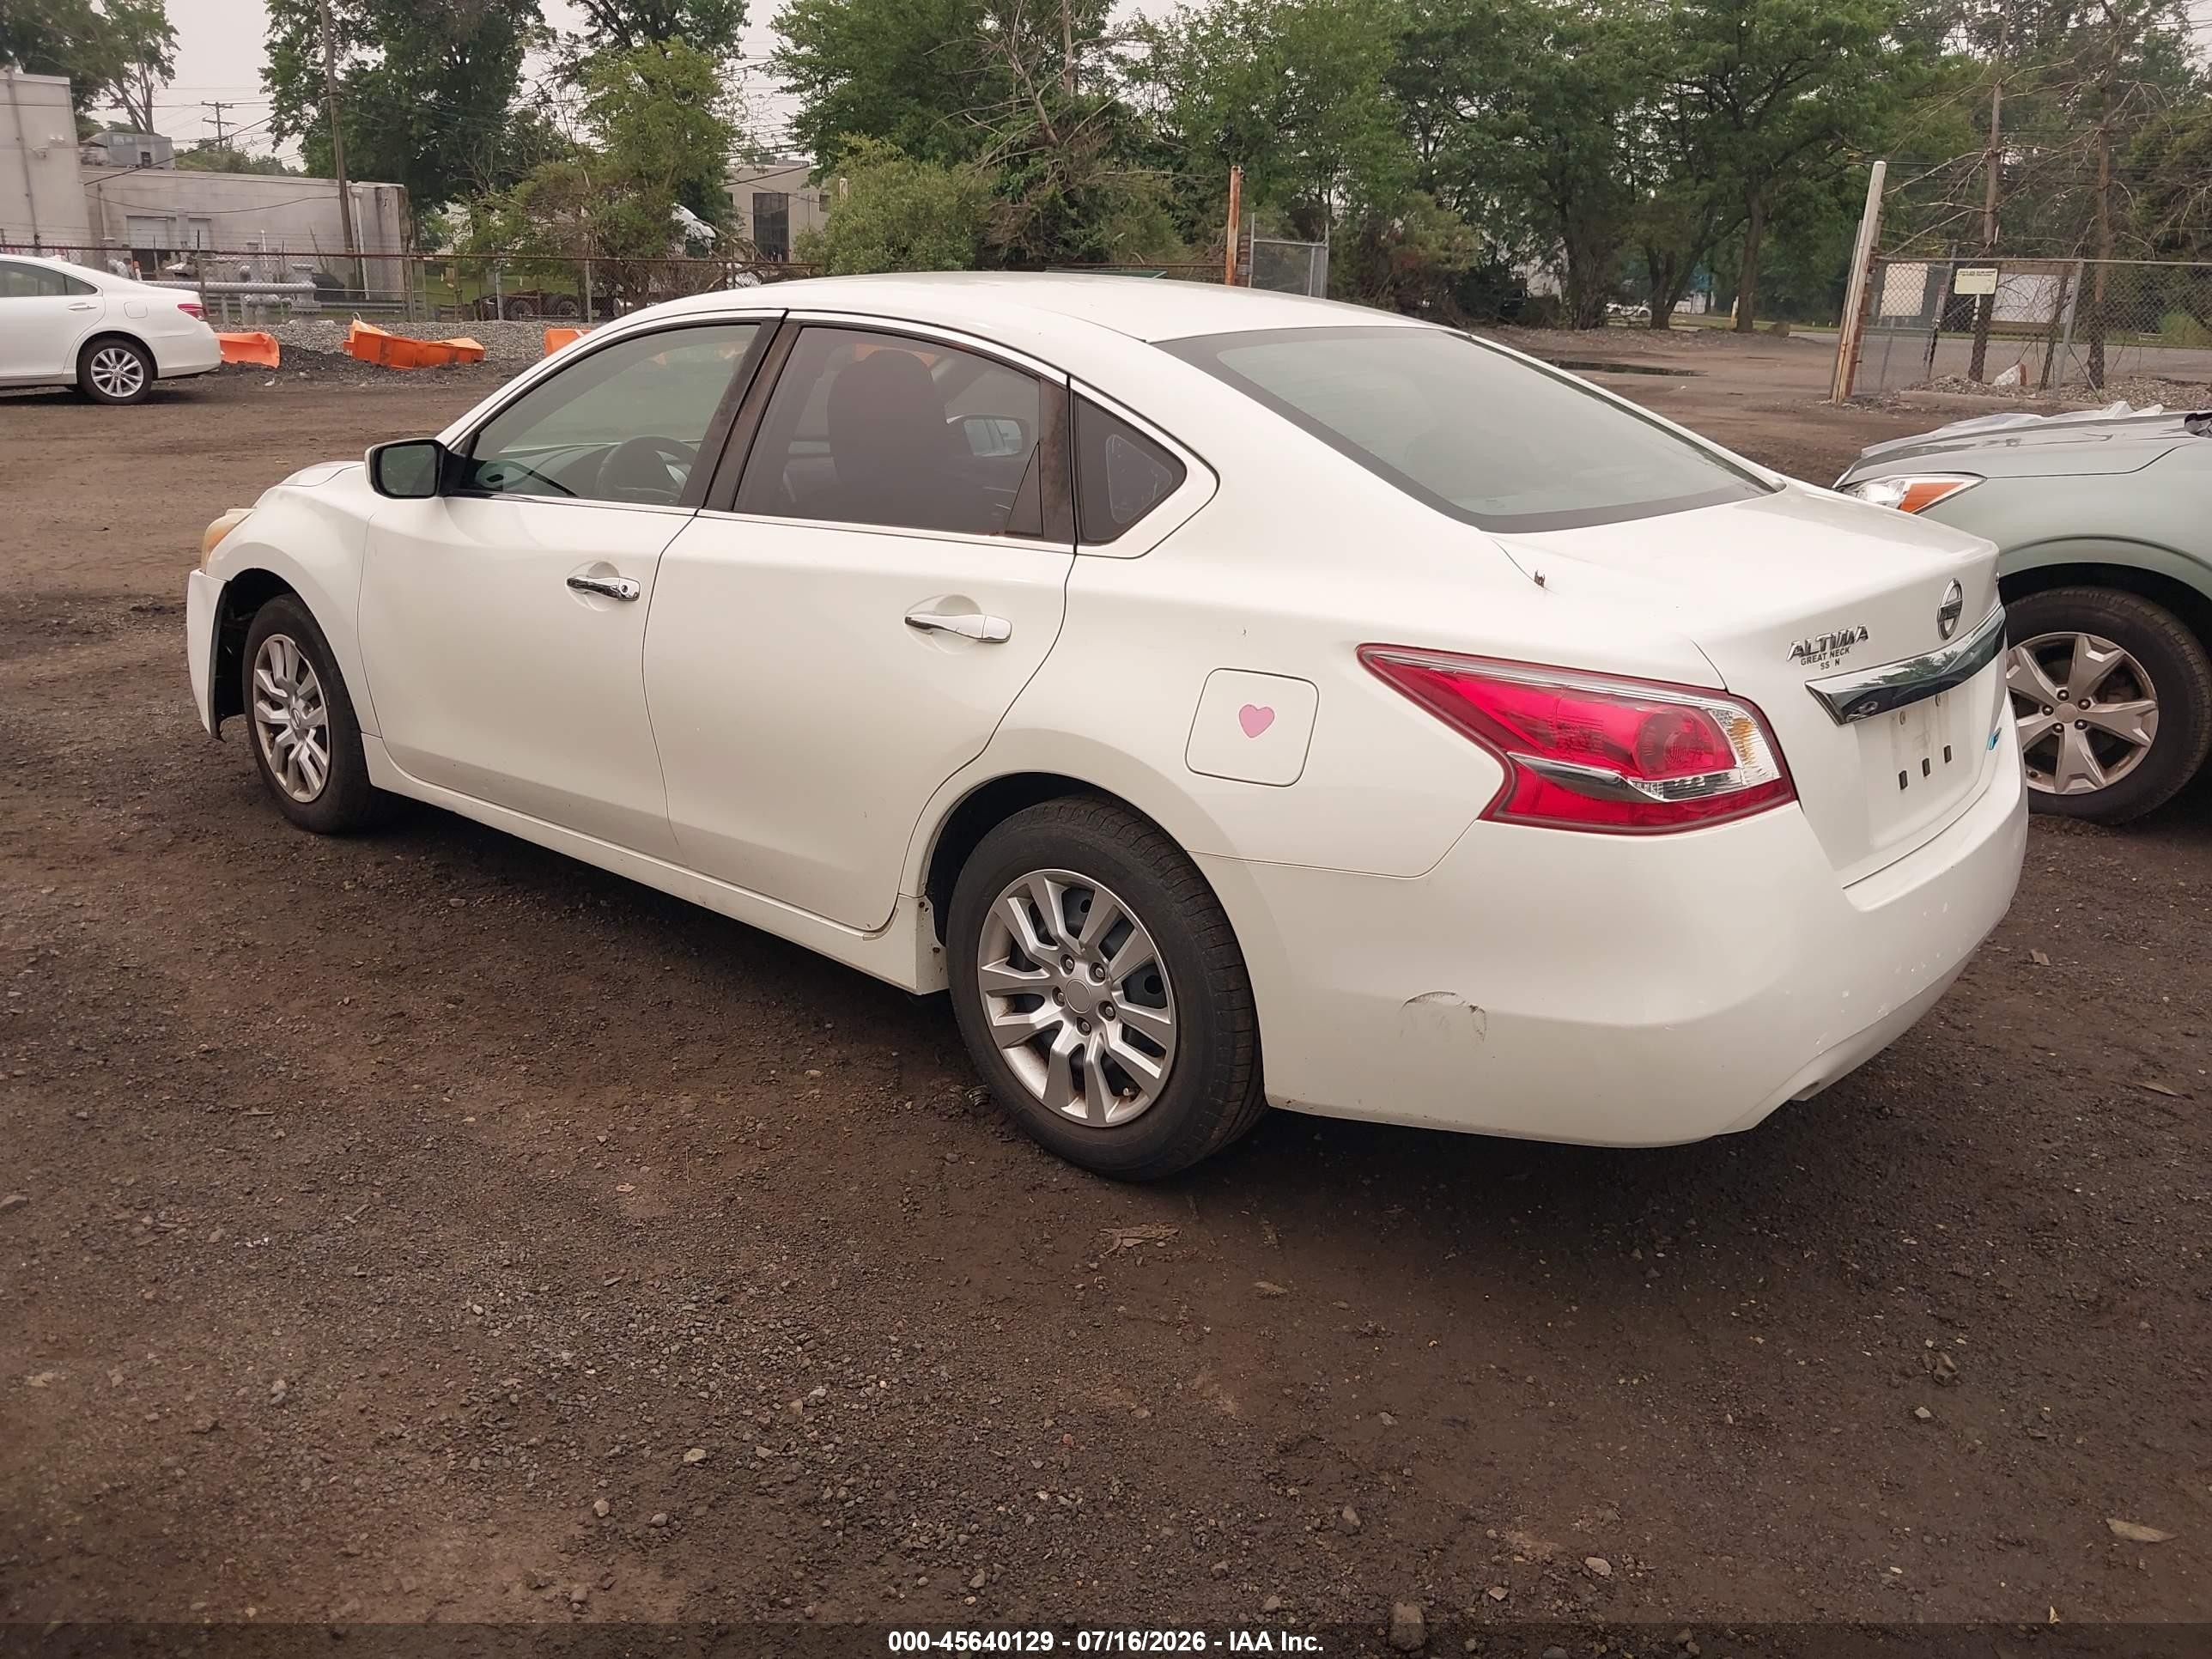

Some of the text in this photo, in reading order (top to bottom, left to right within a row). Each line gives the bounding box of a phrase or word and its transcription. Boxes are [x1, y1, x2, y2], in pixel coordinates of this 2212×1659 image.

[1787, 624, 1869, 661] ALTIMA
[1801, 646, 1850, 665] GREAT NECK
